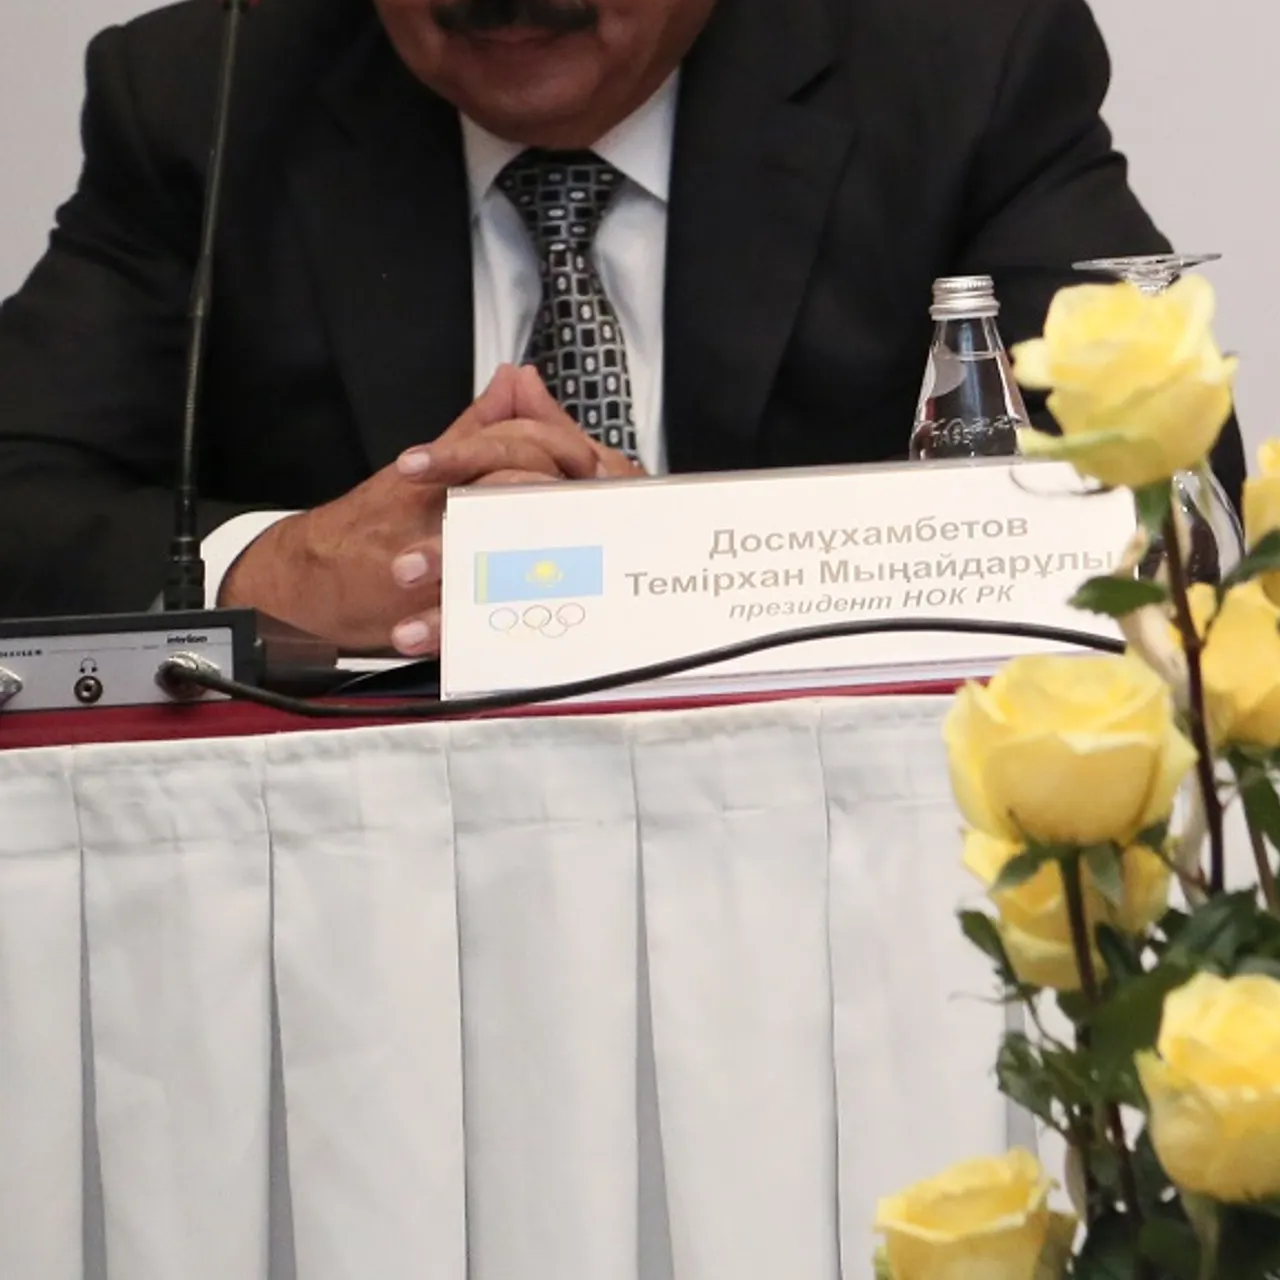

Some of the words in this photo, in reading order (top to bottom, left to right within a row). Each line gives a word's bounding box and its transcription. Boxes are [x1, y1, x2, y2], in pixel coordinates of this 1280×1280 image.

[708, 515, 1029, 560] Досмұхамбетов
[624, 567, 805, 597] Темірхан
[819, 550, 1113, 583] Мыңайдарұлы
[728, 593, 893, 622] президент
[902, 585, 968, 609] НОК
[976, 583, 1015, 604] РК
